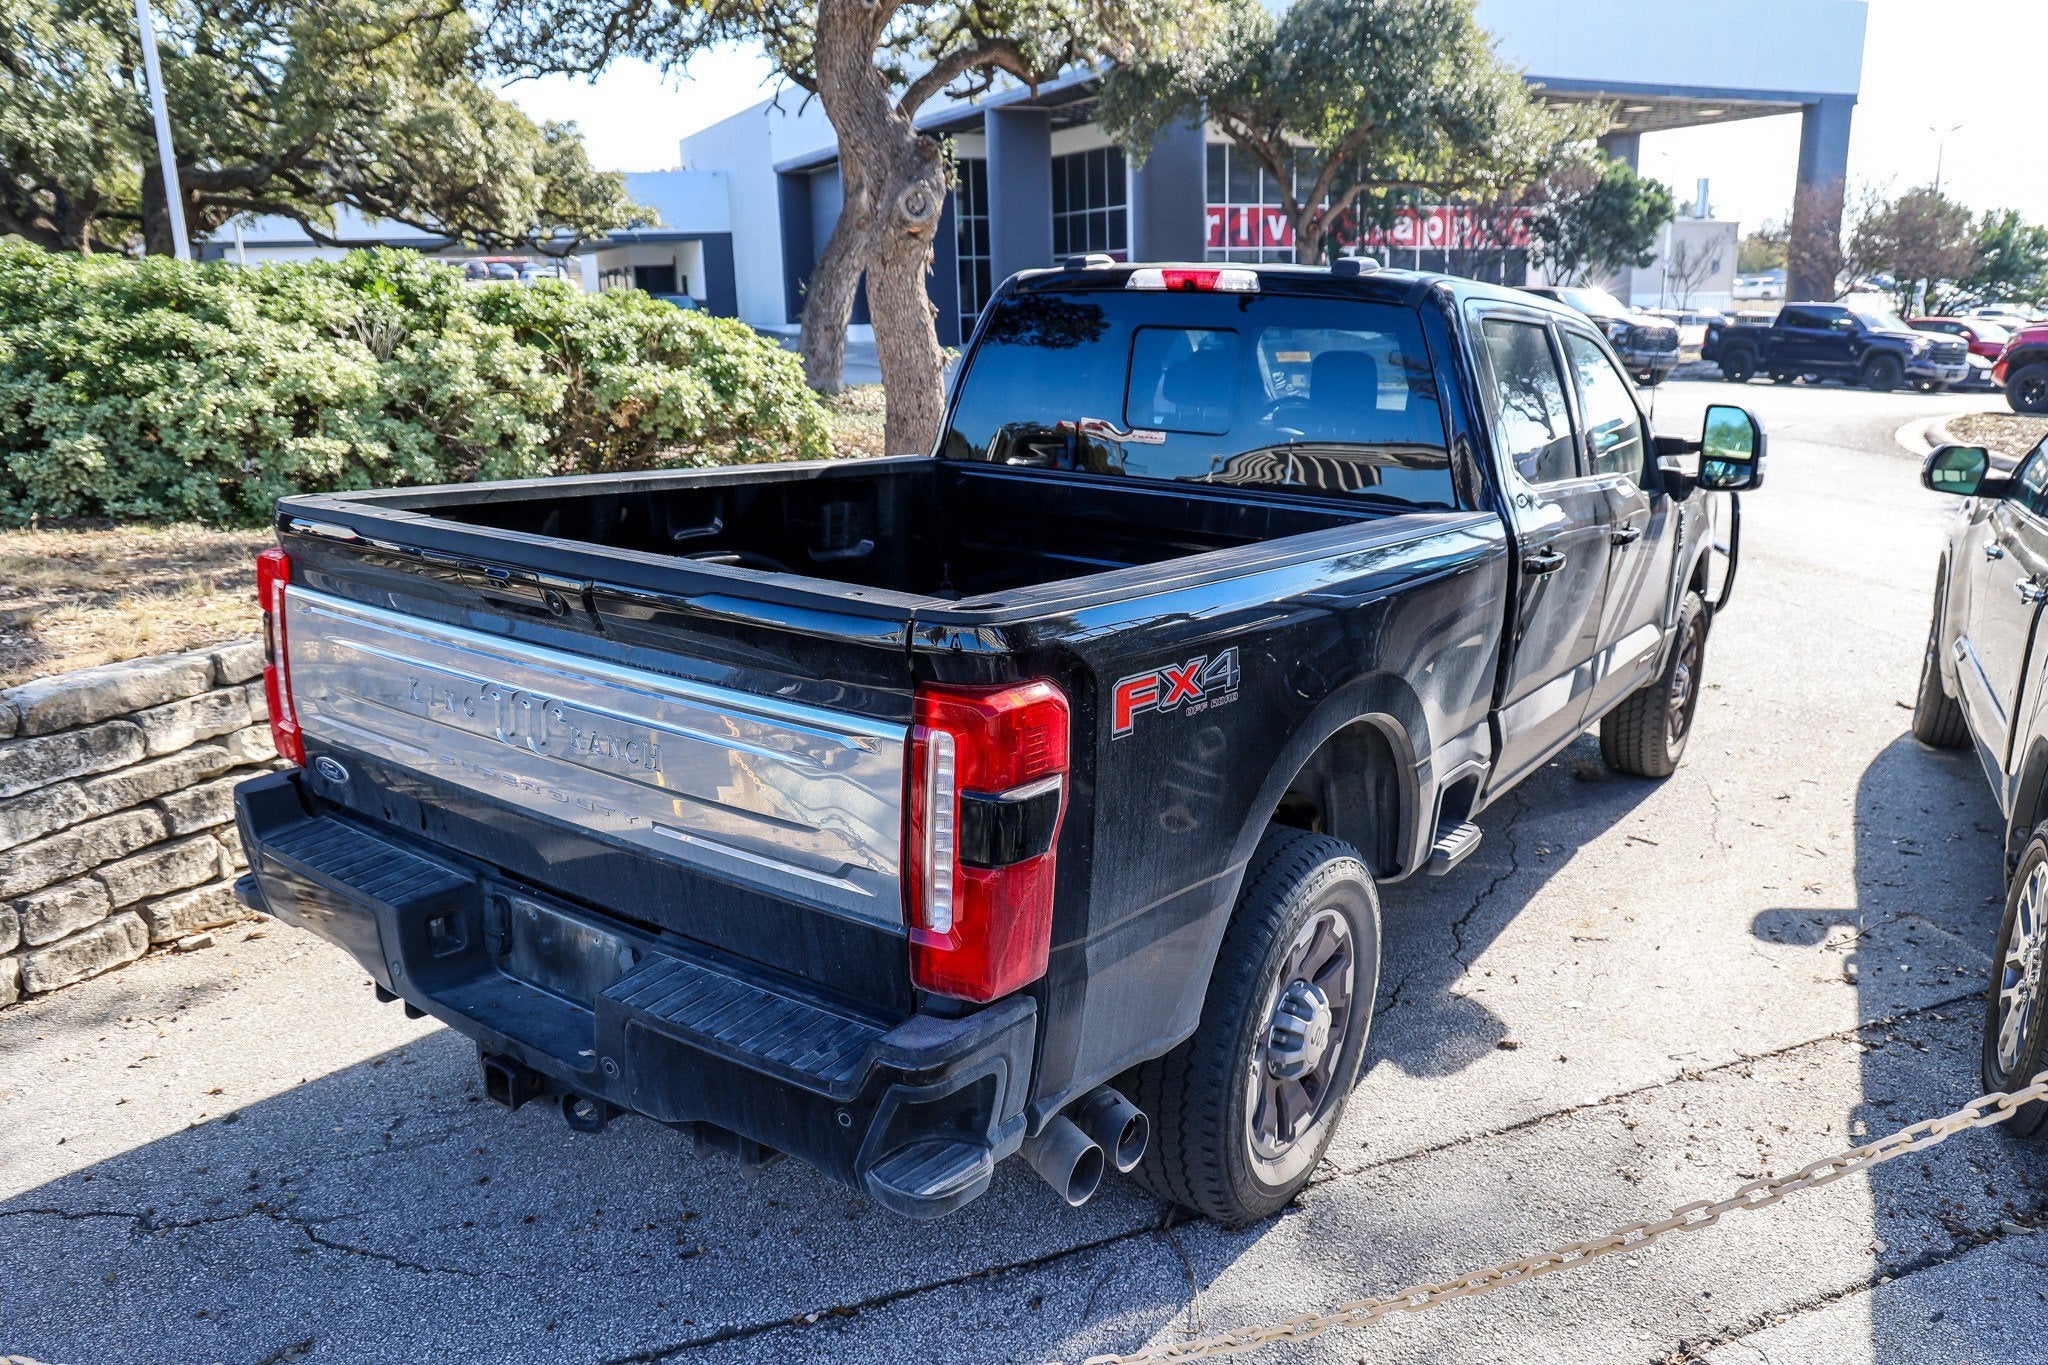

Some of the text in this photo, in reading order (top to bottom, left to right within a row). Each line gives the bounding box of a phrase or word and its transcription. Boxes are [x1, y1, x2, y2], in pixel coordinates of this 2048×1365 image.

[407, 676, 661, 772] KING RANCH
[1112, 646, 1240, 740] FX4
[1185, 691, 1239, 717] OFF ROAD
